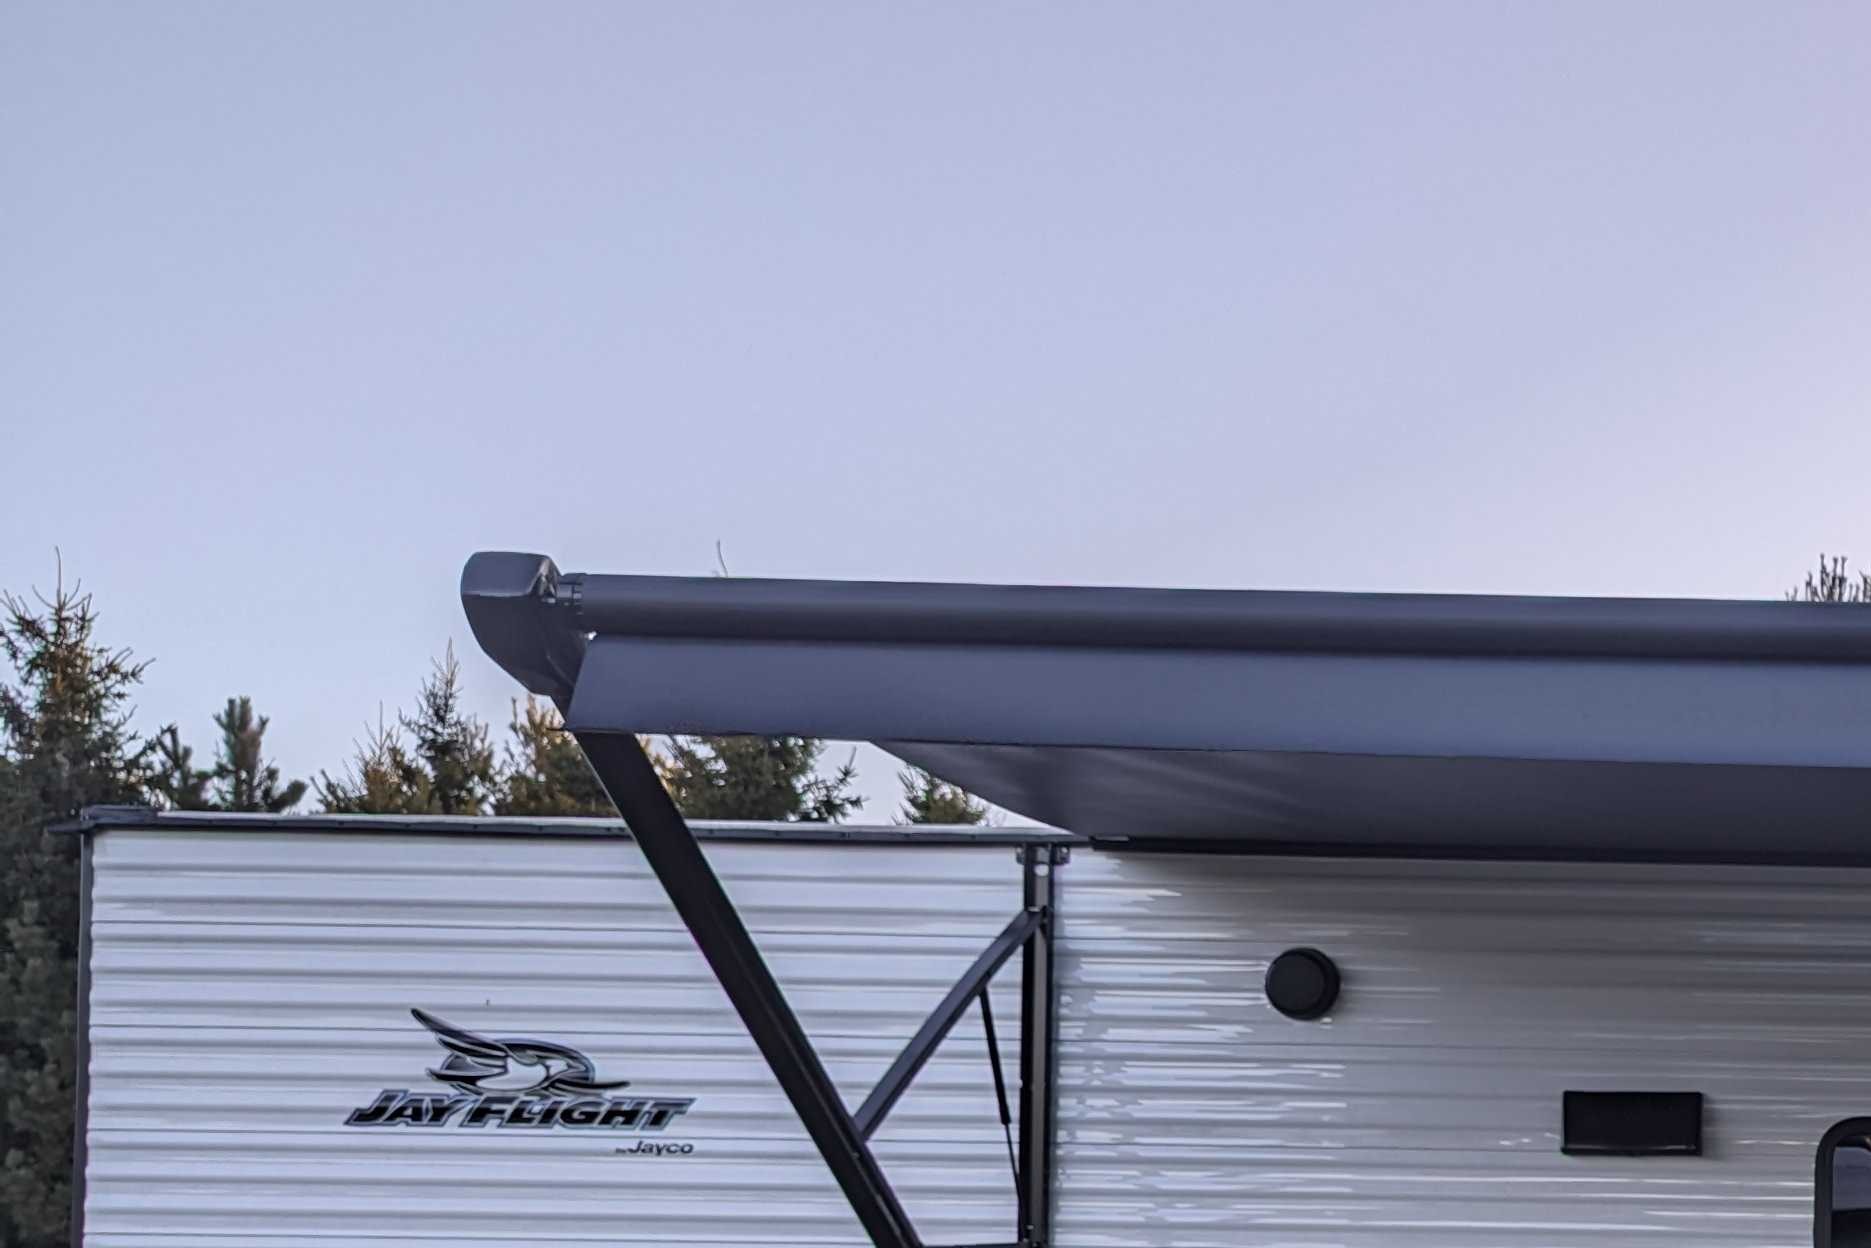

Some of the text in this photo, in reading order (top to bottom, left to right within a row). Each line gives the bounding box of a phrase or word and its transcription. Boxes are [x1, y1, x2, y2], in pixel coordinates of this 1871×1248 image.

[343, 1089, 698, 1130] JAY FLIGHT
[627, 1140, 694, 1156] Jayco
